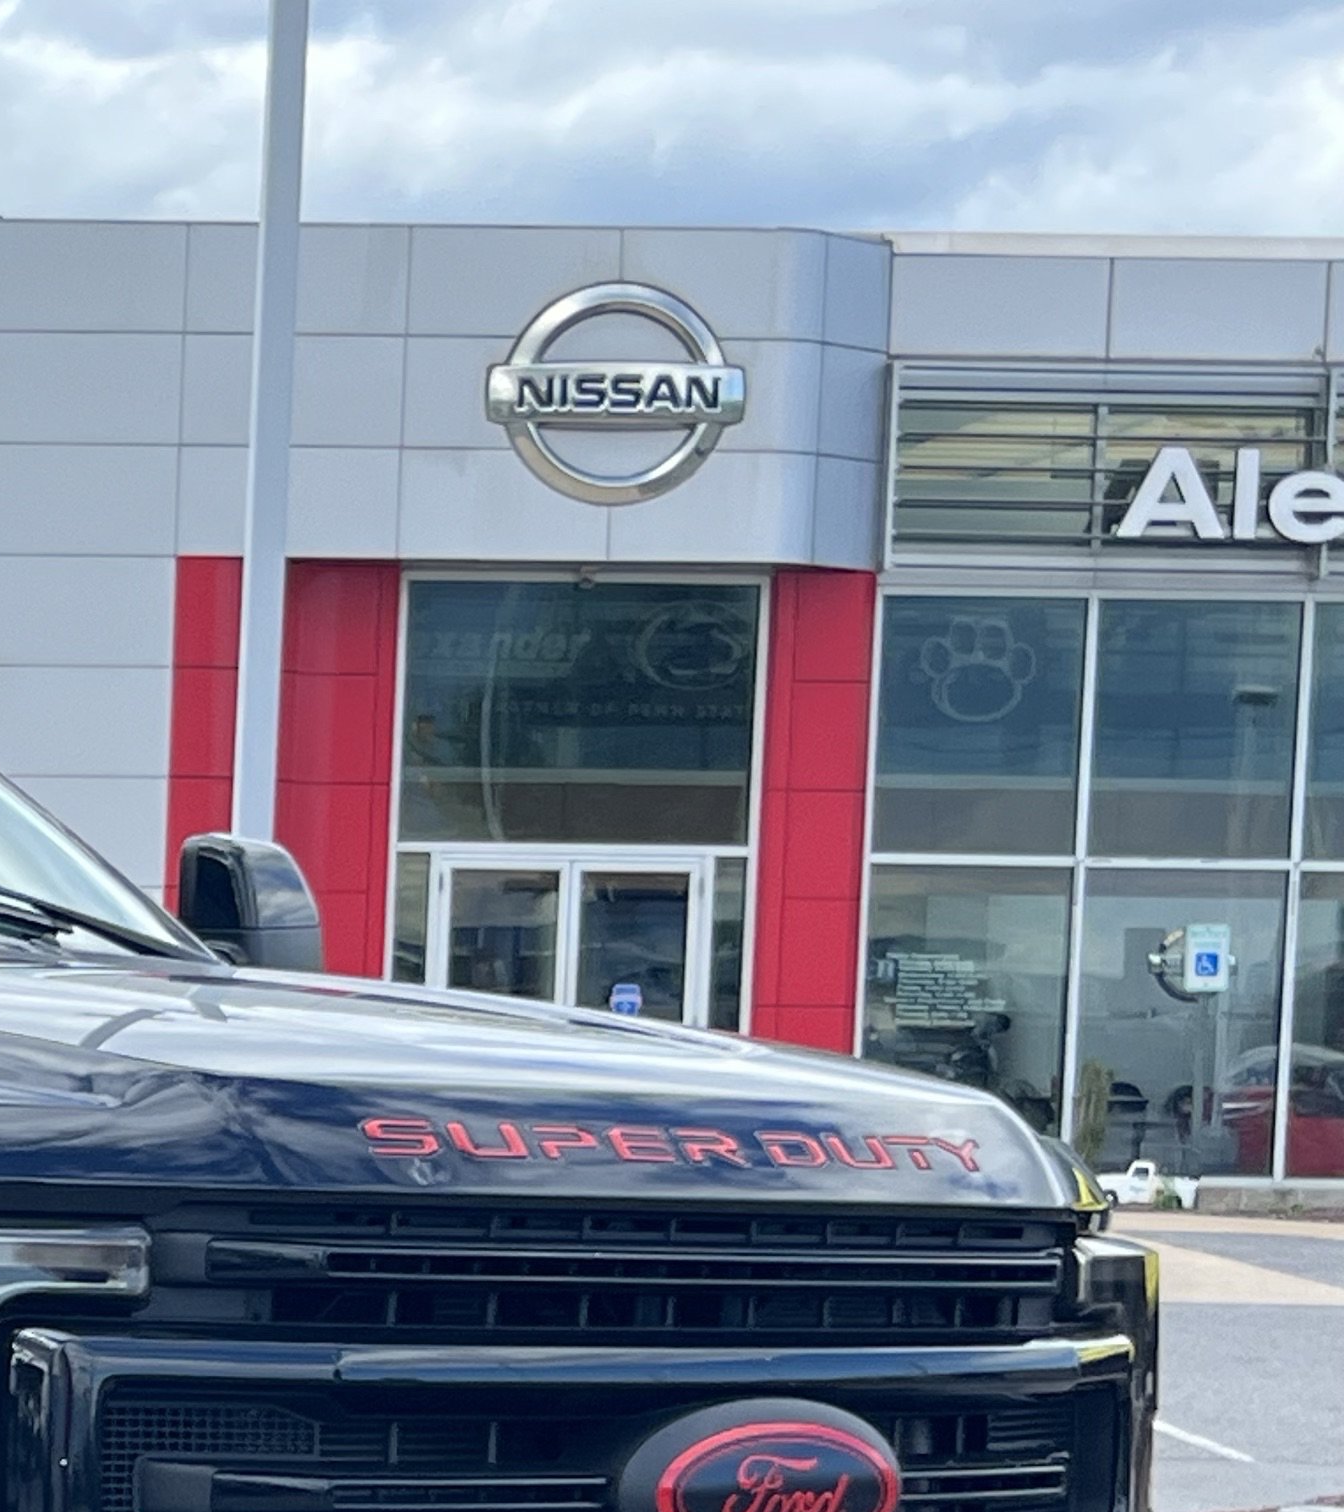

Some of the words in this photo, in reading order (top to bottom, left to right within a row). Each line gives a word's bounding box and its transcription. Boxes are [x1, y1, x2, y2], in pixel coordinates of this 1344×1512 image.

[514, 374, 724, 413] NISSAN
[1116, 446, 1344, 543] Ale
[359, 1115, 748, 1166] SUPER
[753, 1128, 982, 1173] DUTY
